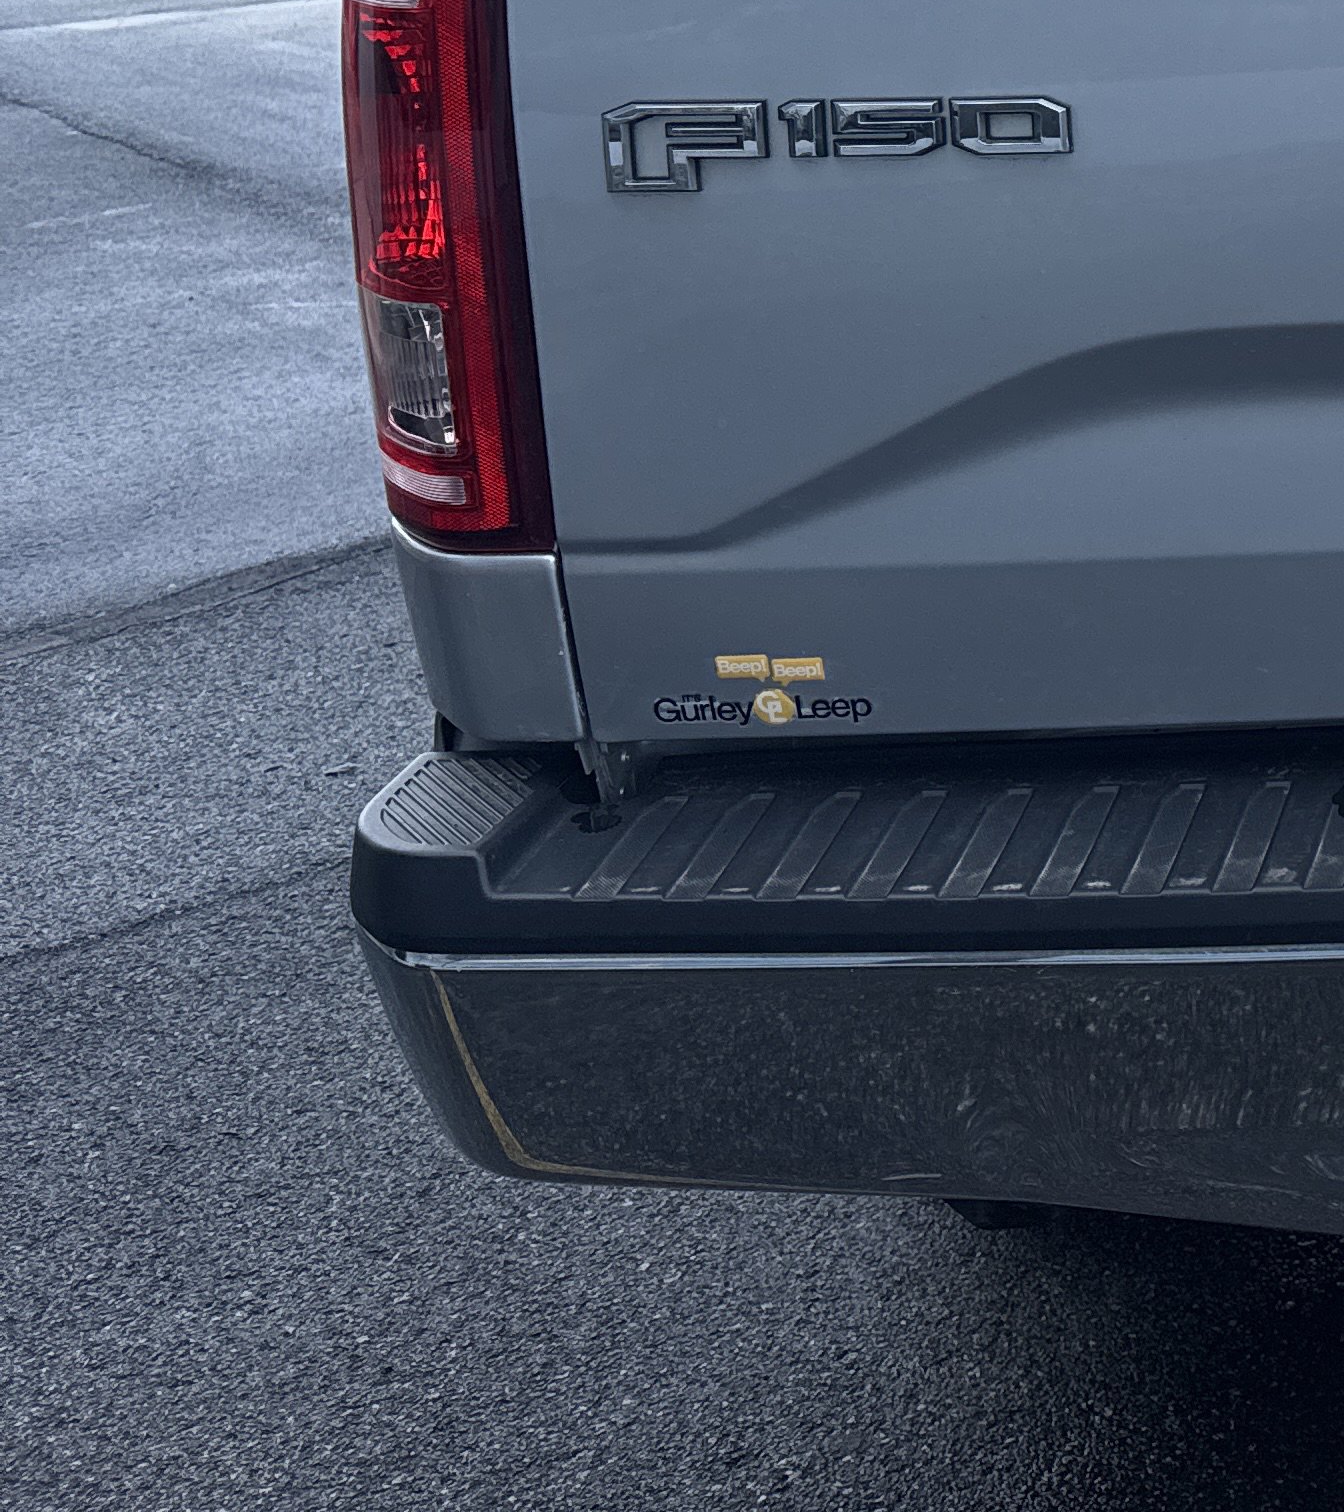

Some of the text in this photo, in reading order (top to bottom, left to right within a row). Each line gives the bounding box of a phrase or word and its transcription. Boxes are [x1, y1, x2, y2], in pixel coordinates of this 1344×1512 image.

[716, 659, 821, 678] Beep! Beep!
[654, 696, 751, 726] Gurley
[795, 694, 872, 722] Leep
